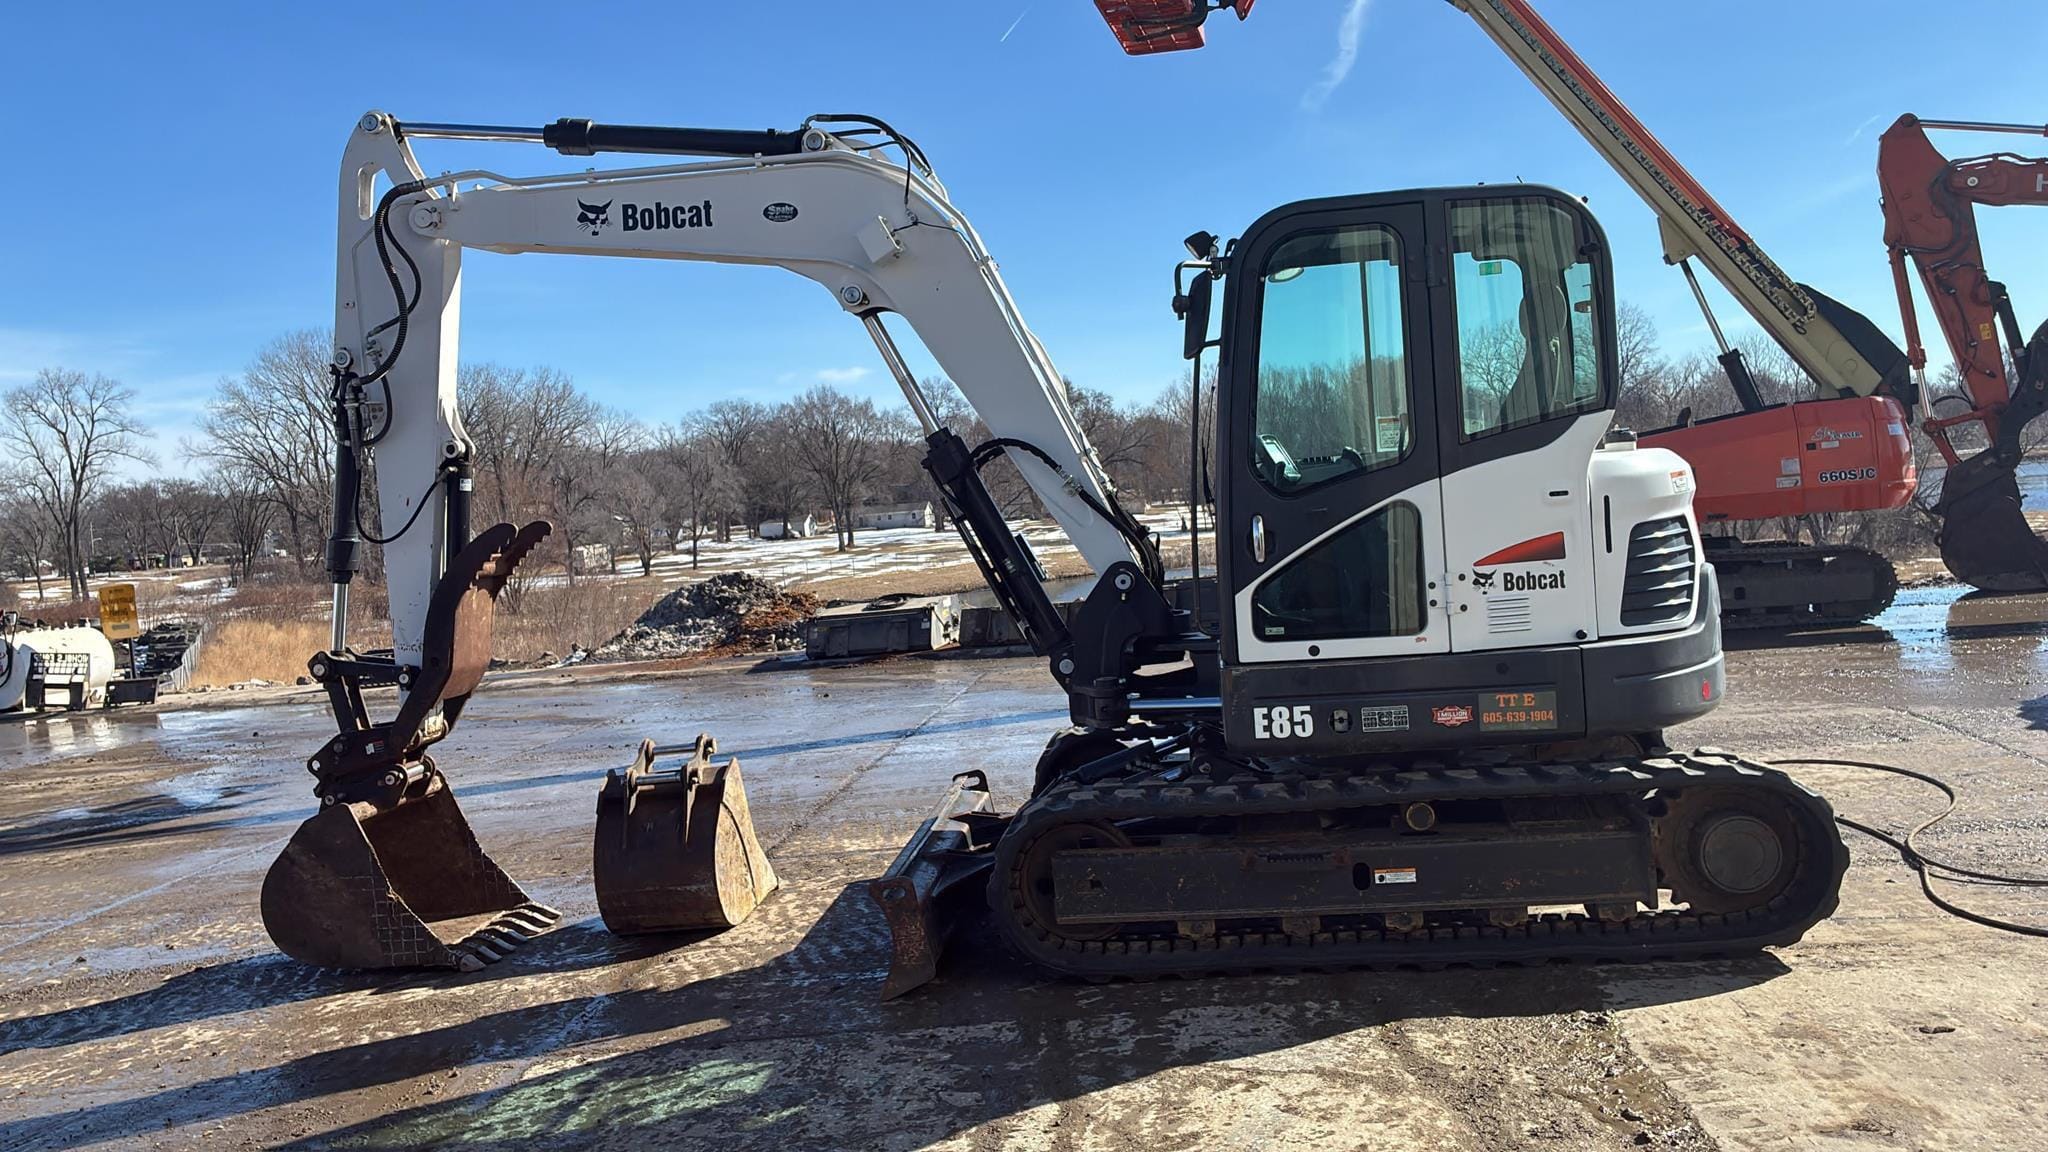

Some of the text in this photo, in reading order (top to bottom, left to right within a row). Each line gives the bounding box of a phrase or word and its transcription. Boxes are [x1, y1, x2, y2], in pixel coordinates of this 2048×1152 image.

[621, 200, 713, 232] Bobcat
[1819, 467, 1876, 483] 660SJC
[1503, 570, 1566, 592] Bobcat
[1522, 693, 1536, 707] E
[1253, 705, 1314, 739] E85
[1483, 710, 1554, 723] 605-639-1904
